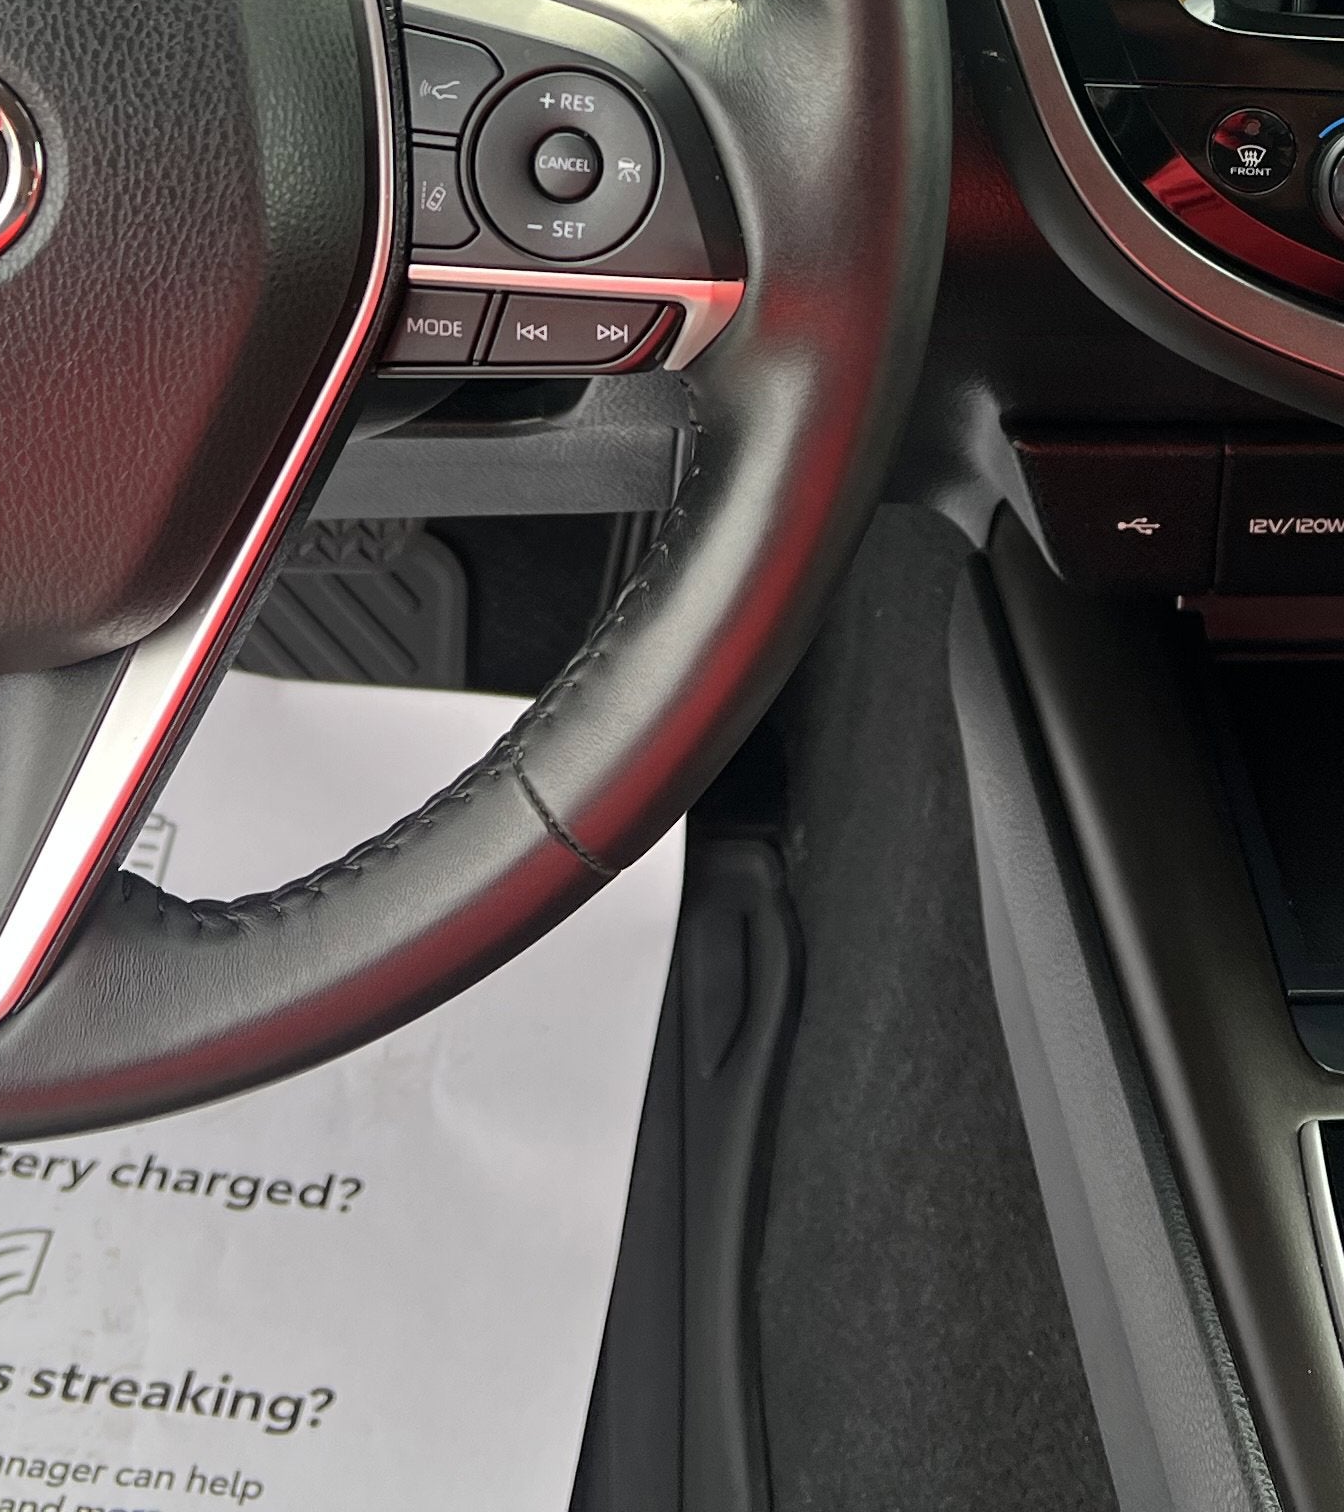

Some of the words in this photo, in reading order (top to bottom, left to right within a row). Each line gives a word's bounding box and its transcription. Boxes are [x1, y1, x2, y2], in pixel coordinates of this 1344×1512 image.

[560, 93, 595, 113] RES
[538, 155, 591, 174] CANCEL
[1230, 165, 1272, 177] FRONT
[552, 221, 586, 239] SET
[407, 317, 463, 338] MODE
[111, 1154, 366, 1213] charged?
[28, 1369, 338, 1436] streaking?
[115, 1466, 176, 1490] can
[185, 1464, 265, 1505] help
